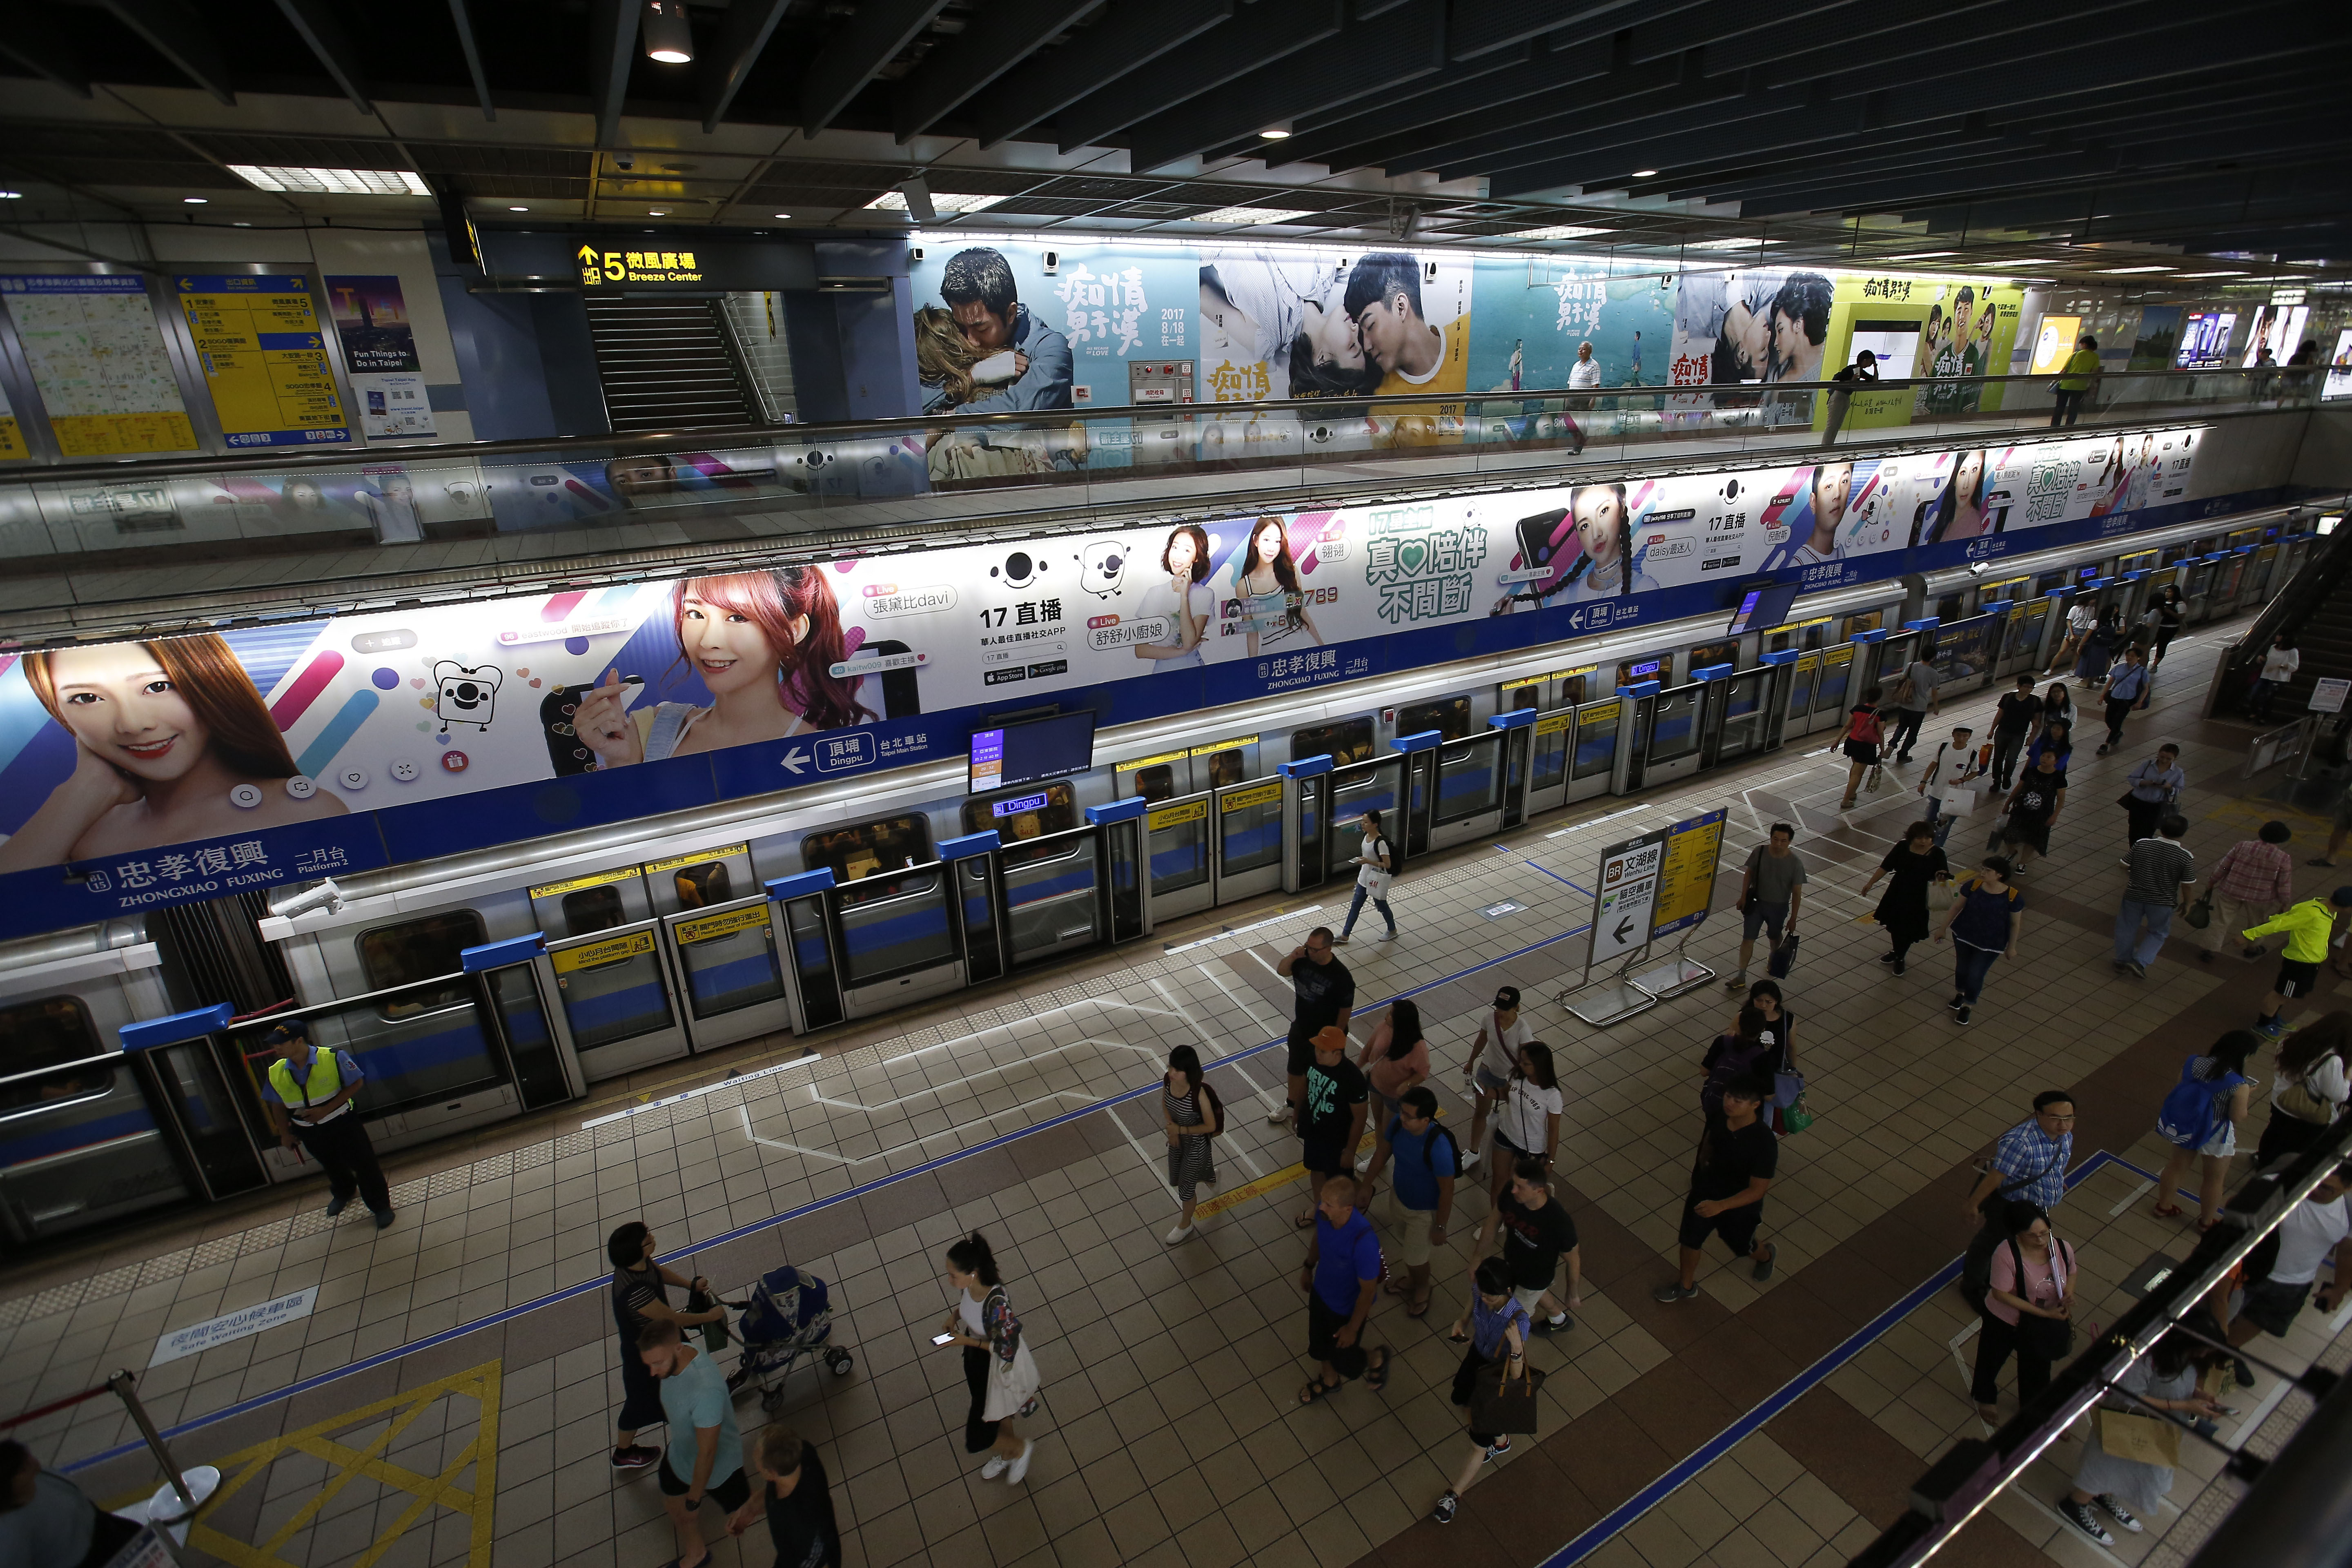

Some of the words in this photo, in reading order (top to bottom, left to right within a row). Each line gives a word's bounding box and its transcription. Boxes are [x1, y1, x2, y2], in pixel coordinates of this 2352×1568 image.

[604, 252, 626, 281] 5
[625, 252, 696, 270] 微風廣場
[582, 267, 601, 285] 出口
[628, 272, 666, 281] Breeze
[668, 272, 702, 281] Center
[1054, 262, 1148, 312] 痴情
[186, 299, 193, 309] 1
[299, 298, 308, 307] 5
[1161, 308, 1184, 320] 2017
[1065, 307, 1143, 356] 男子漢
[1161, 322, 1184, 334] 8/18
[198, 339, 208, 348] 2
[1161, 335, 1185, 346] 在一起
[315, 352, 323, 361] 3
[1934, 350, 1965, 376] 痴情
[1671, 352, 1709, 379] 痴情
[1207, 359, 1271, 393] 痴情
[324, 382, 332, 391] 4
[1440, 405, 1457, 414] 2017
[2172, 460, 2179, 470] 17
[2054, 461, 2081, 490] 陪伴
[2026, 491, 2069, 522] 不間斷
[1709, 516, 1722, 530] 17
[1723, 512, 1746, 530] 直播
[1325, 532, 1340, 540] Live
[1366, 537, 1399, 586] 真
[1429, 527, 1488, 574] 陪伴
[1650, 541, 1691, 557] daisy最迷人
[1807, 563, 1843, 581] 忠孝復興
[1845, 570, 1858, 578] 二月台
[876, 585, 894, 595] Live
[1804, 581, 1827, 590] ZHONGXIAO
[872, 590, 949, 615] 張黛比davi
[1305, 586, 1339, 606] 789
[1377, 572, 1473, 624] 不間斷
[979, 607, 1007, 628] 17
[1015, 597, 1062, 626] 直播
[1592, 606, 1608, 618] 頂埔
[1616, 606, 1639, 616] 台北車站
[521, 626, 568, 639] eastwood
[572, 617, 628, 633] 開始追蹤你了
[1100, 616, 1116, 626] Live
[1278, 615, 1286, 626] 6
[980, 626, 1066, 647] 華人最佳直播社交APP
[1096, 623, 1163, 646] 舒舒小廚娘
[847, 661, 882, 672] kaitw009
[884, 655, 915, 667] 喜歡主播
[996, 652, 1009, 660] 直播
[1271, 649, 1337, 677] 忠孝復興
[1345, 657, 1369, 670] 二月台
[1009, 672, 1023, 680] Store
[1345, 667, 1365, 675] Platform
[1639, 663, 1655, 673] Dingpu
[1268, 675, 1311, 690] ZHONGXIAO
[1314, 670, 1339, 682] FUXING
[828, 738, 860, 761] 頂埔
[879, 733, 927, 751] 台北車站
[880, 748, 895, 757] Taipei
[909, 744, 928, 753] Station
[830, 753, 862, 768] Dingpu
[1008, 797, 1040, 811] Dingpu
[116, 840, 268, 889] 忠孝復興
[294, 846, 345, 866] 二月台
[1624, 849, 1658, 872] 文湖線
[297, 861, 341, 874] Platform
[1608, 866, 1621, 878] BR
[1624, 868, 1643, 878] Wenhu
[92, 881, 107, 889] 15
[119, 880, 218, 908] ZHONGXIAO
[226, 869, 284, 887] FUXING
[1619, 880, 1653, 900] 貓空纜車
[699, 911, 760, 931] 關門時勿強行進出
[742, 920, 756, 929] closing
[1257, 918, 1283, 927] Waiting
[578, 942, 628, 960] 小心月台間隙
[600, 952, 620, 962] platform
[722, 1073, 760, 1087] Waiting
[763, 1065, 784, 1074] Line
[1518, 1089, 1530, 1100] LOVE
[1530, 1098, 1540, 1110] 1969
[1196, 1184, 1259, 1219] 排隊終止線
[171, 1294, 305, 1348] 夜間安心候車區
[180, 1340, 207, 1353] Safe
[210, 1324, 255, 1342] Waiting
[258, 1313, 287, 1328] Zone
